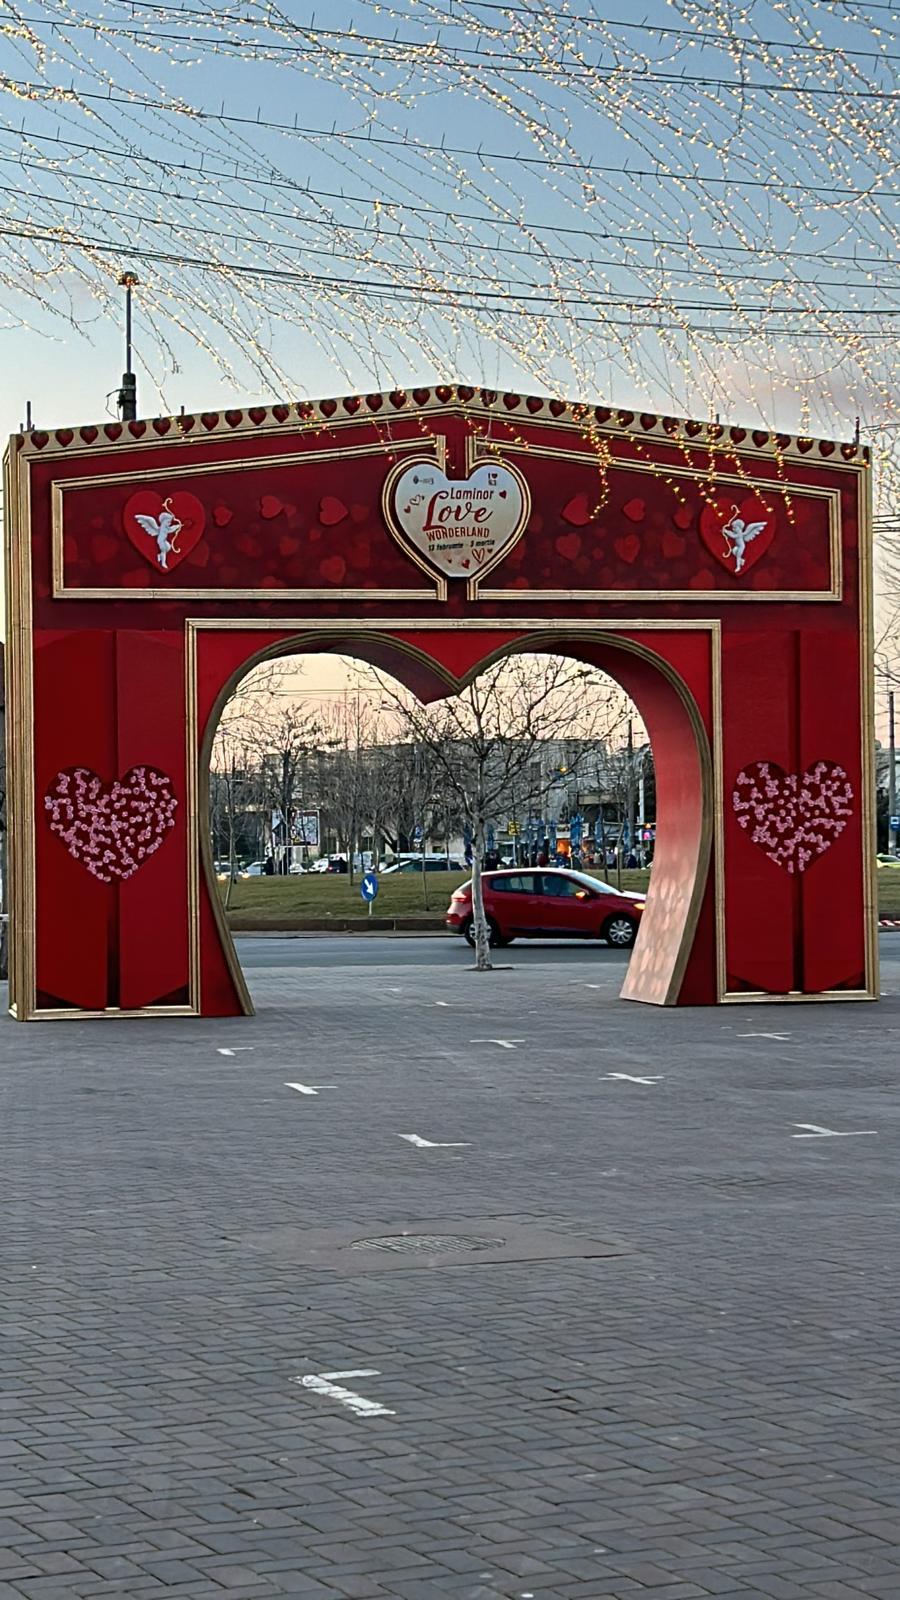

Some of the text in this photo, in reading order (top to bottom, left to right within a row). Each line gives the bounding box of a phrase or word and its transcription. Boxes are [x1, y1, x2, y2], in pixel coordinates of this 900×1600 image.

[450, 487, 494, 500] Laminor
[422, 490, 493, 531] Love
[426, 526, 490, 541] WONDERLAND
